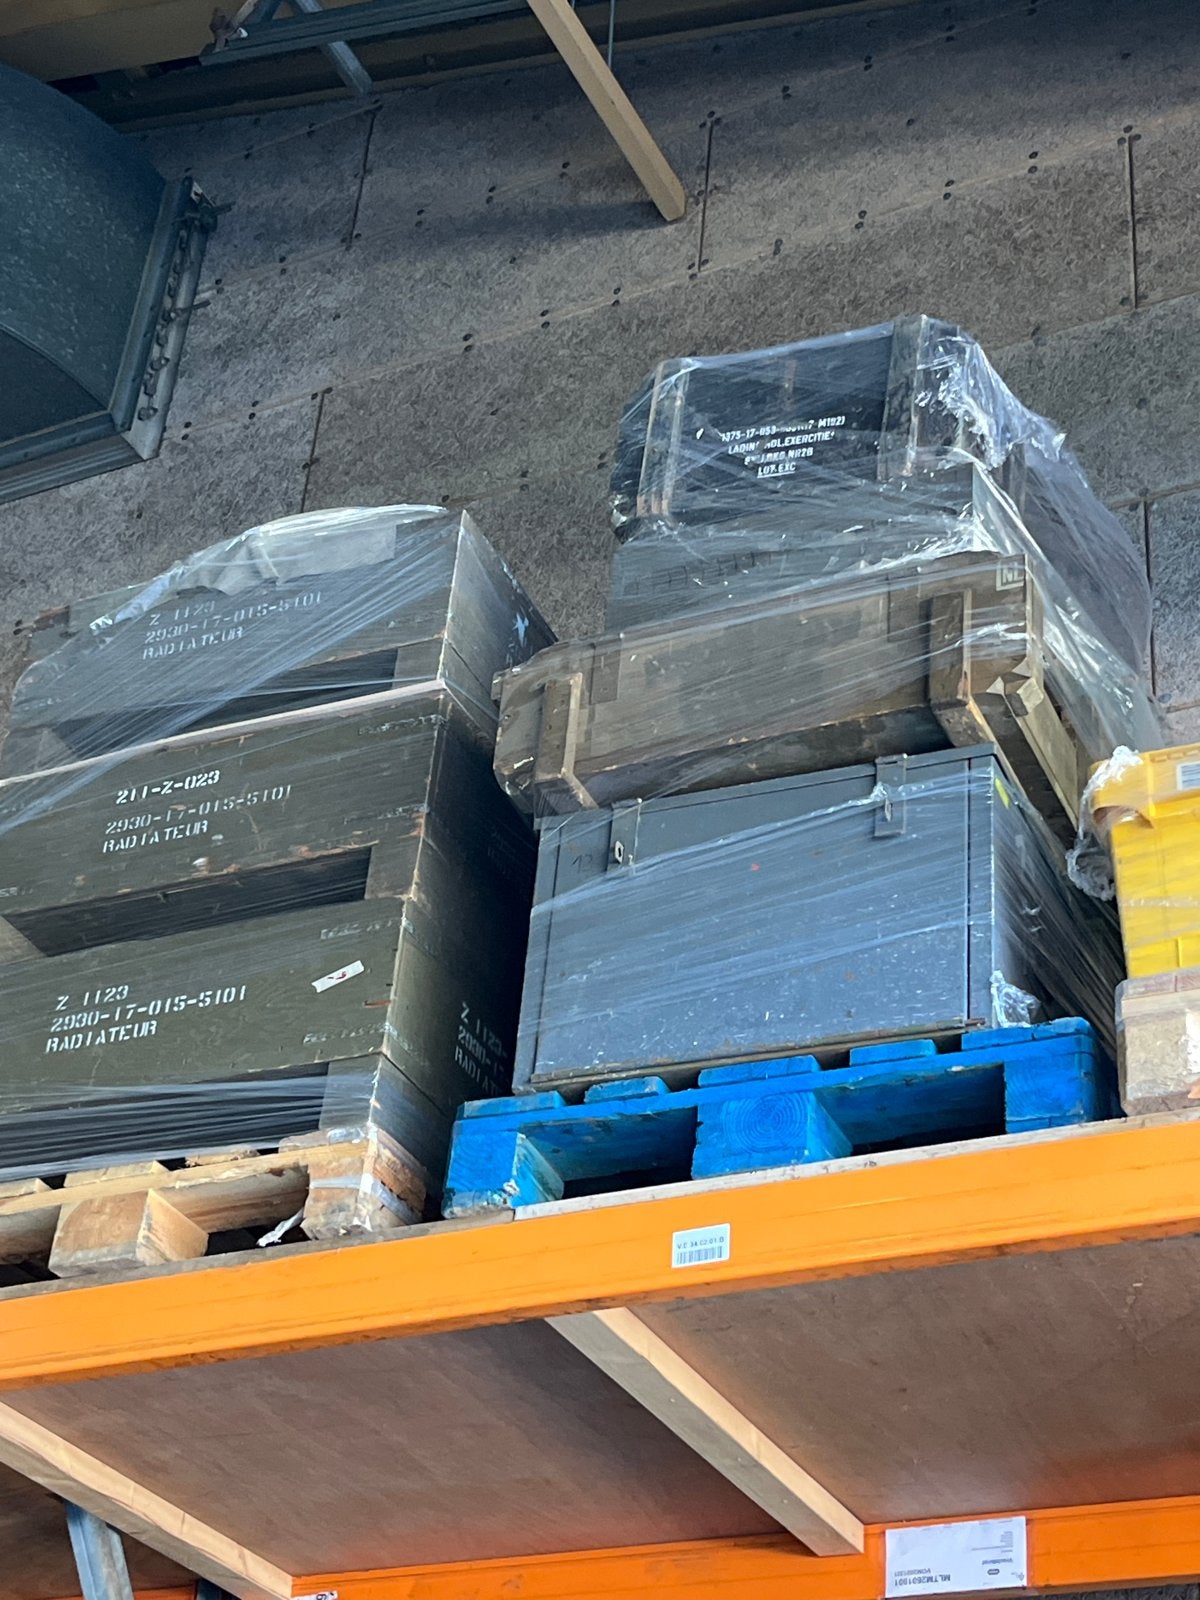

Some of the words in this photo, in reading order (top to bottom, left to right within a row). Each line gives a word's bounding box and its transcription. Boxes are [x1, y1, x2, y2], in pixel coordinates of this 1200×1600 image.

[145, 591, 322, 644] 2930-17-015-5101
[149, 614, 160, 626] Z
[142, 626, 245, 660] RADIATEUR
[115, 769, 221, 805] 211-Z-023
[105, 785, 292, 834] 2930-17-015-5101
[102, 820, 209, 853] RADIATEUR
[50, 985, 247, 1032] 2930-17-015-5101
[55, 995, 70, 1011] Z
[83, 985, 130, 1007] 1123
[45, 1020, 158, 1054] RADIATEUR
